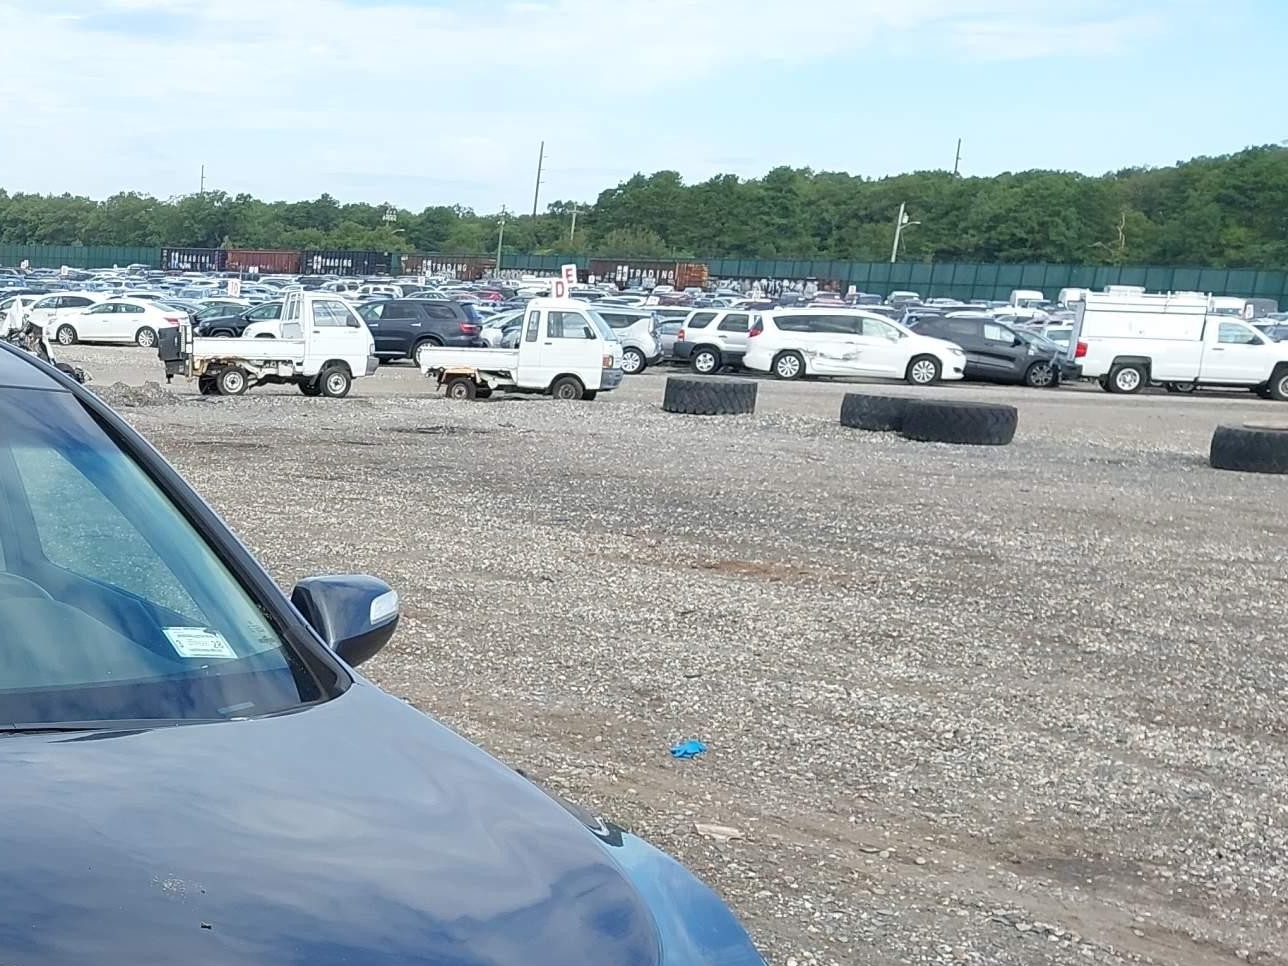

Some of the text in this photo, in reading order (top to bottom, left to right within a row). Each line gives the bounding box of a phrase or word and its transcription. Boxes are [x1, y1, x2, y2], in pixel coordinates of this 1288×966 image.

[432, 262, 468, 272] TRADING
[629, 268, 674, 280] TRADING
[565, 268, 574, 284] E
[555, 280, 565, 298] D
